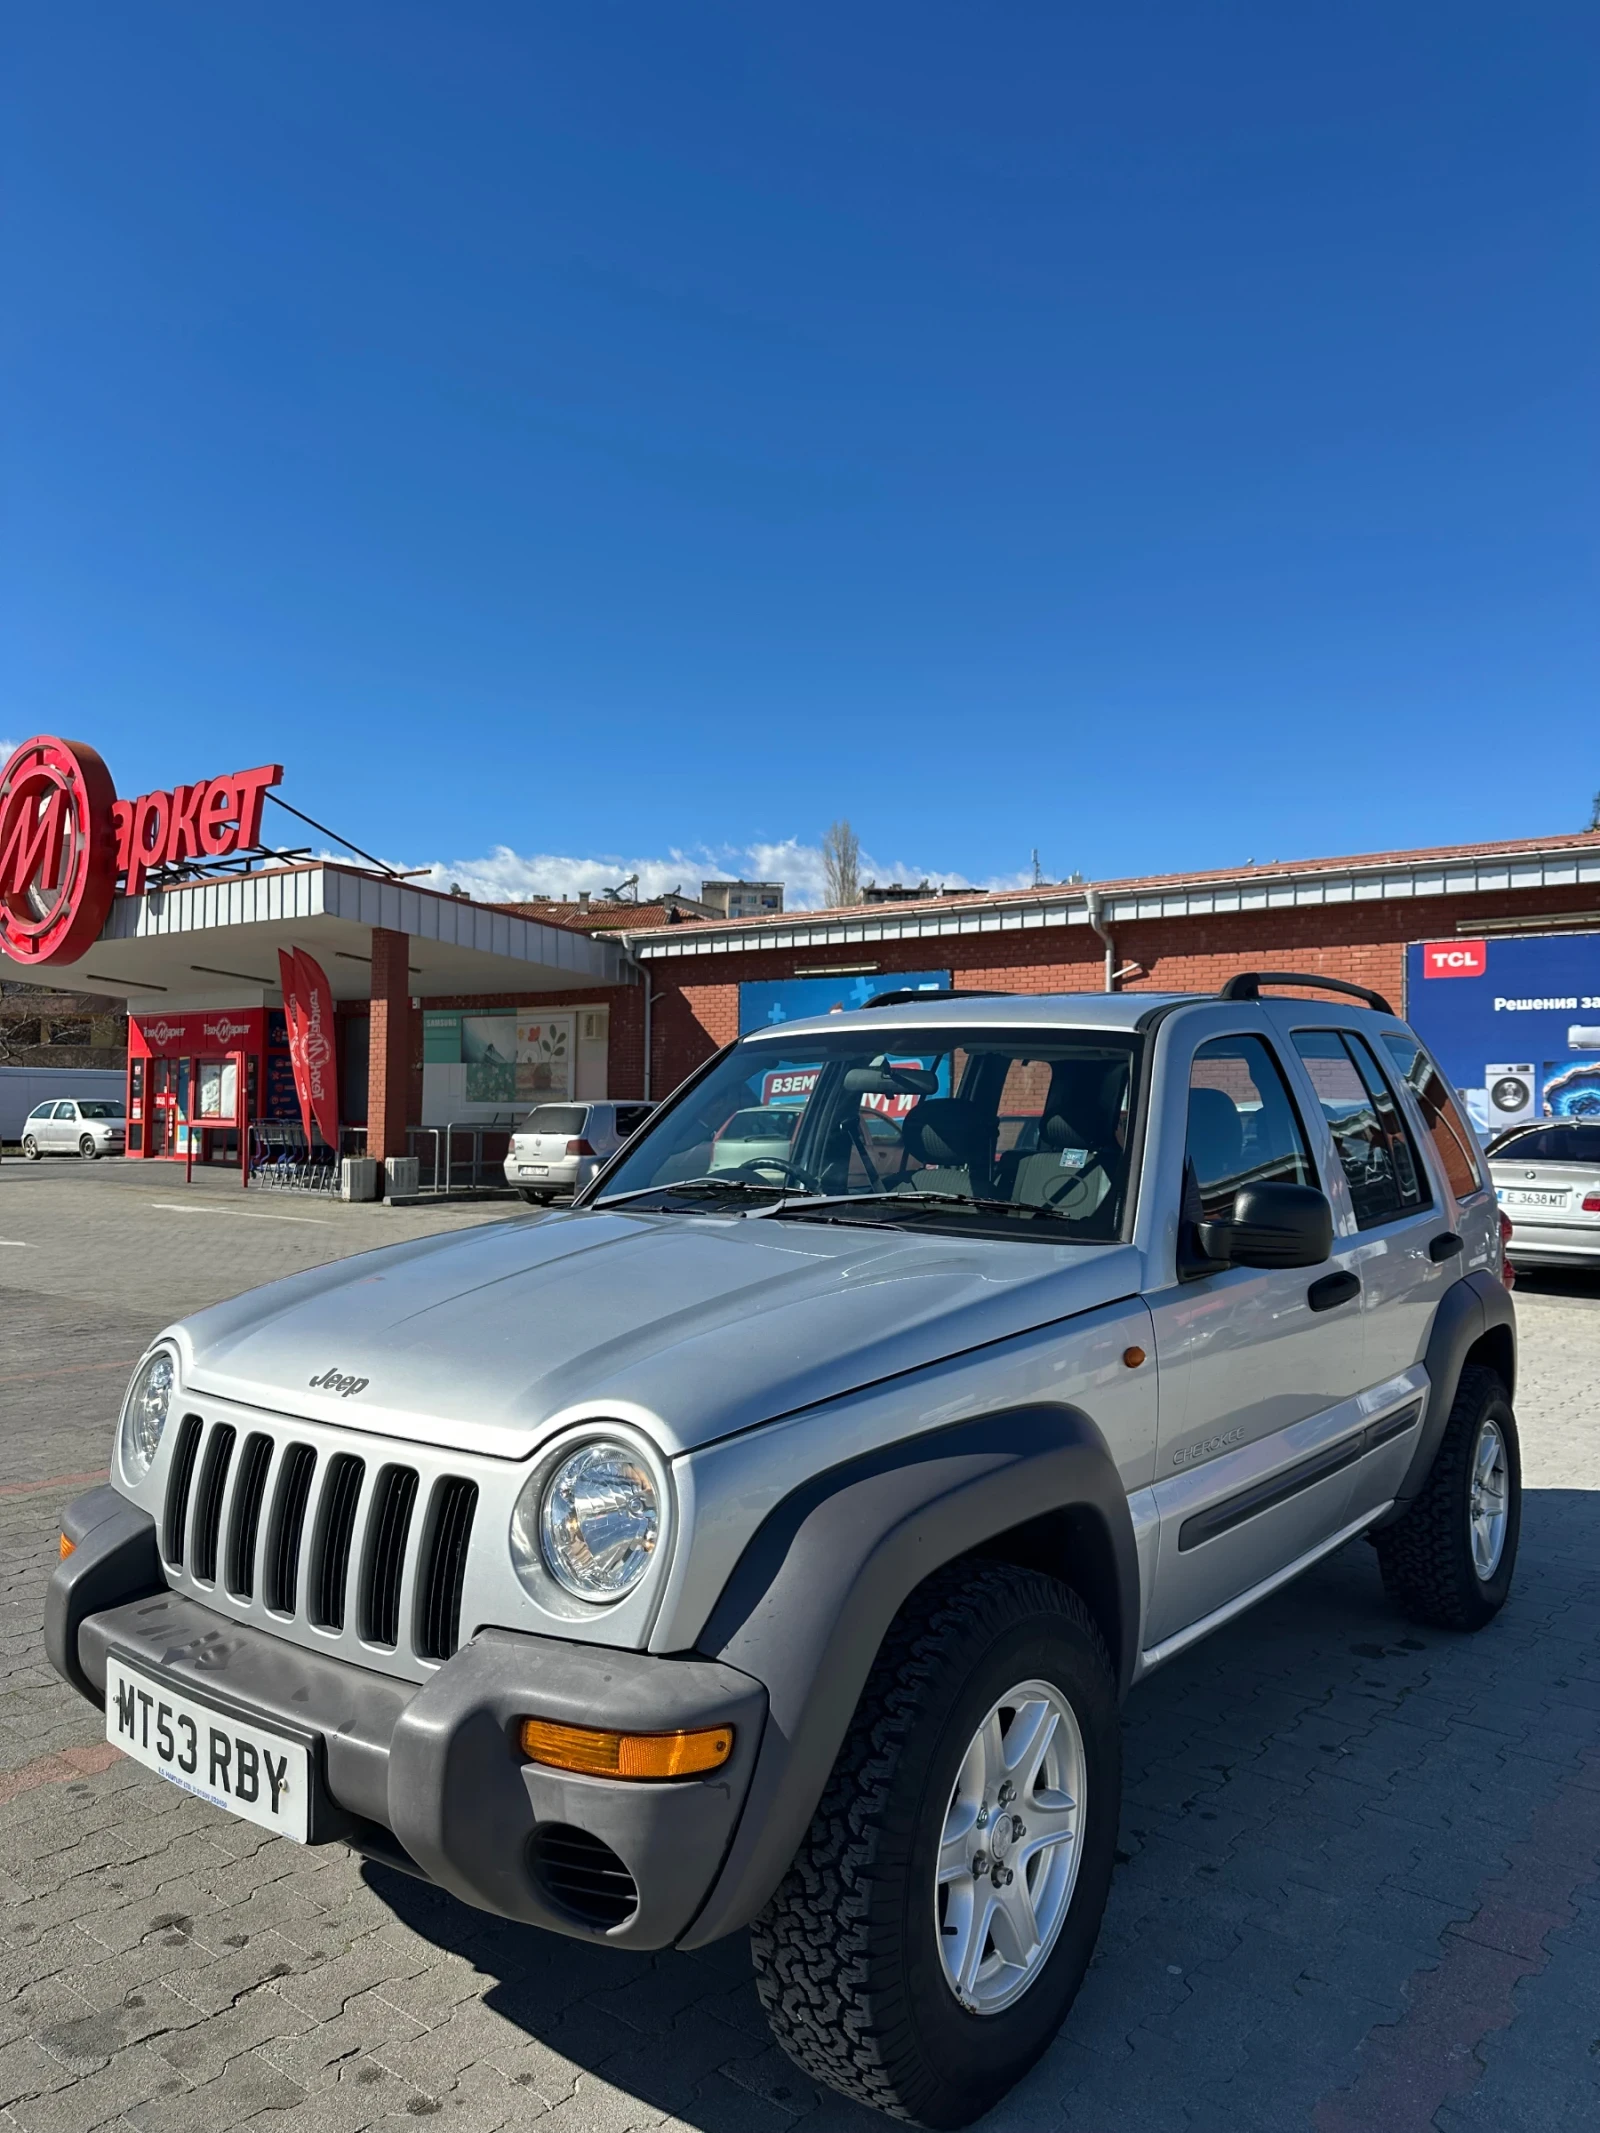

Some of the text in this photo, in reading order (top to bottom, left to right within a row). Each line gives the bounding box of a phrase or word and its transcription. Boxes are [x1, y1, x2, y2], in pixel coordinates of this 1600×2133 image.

[1432, 952, 1478, 968] TCL
[1494, 997, 1578, 1012] Решения
[426, 1018, 457, 1028] SAMSUNG
[1507, 1192, 1565, 1206] E 3638 MT
[309, 1367, 370, 1398] Jeep
[1172, 1426, 1245, 1465] CHEROKEE
[119, 1677, 288, 1815] MT53 RBY
